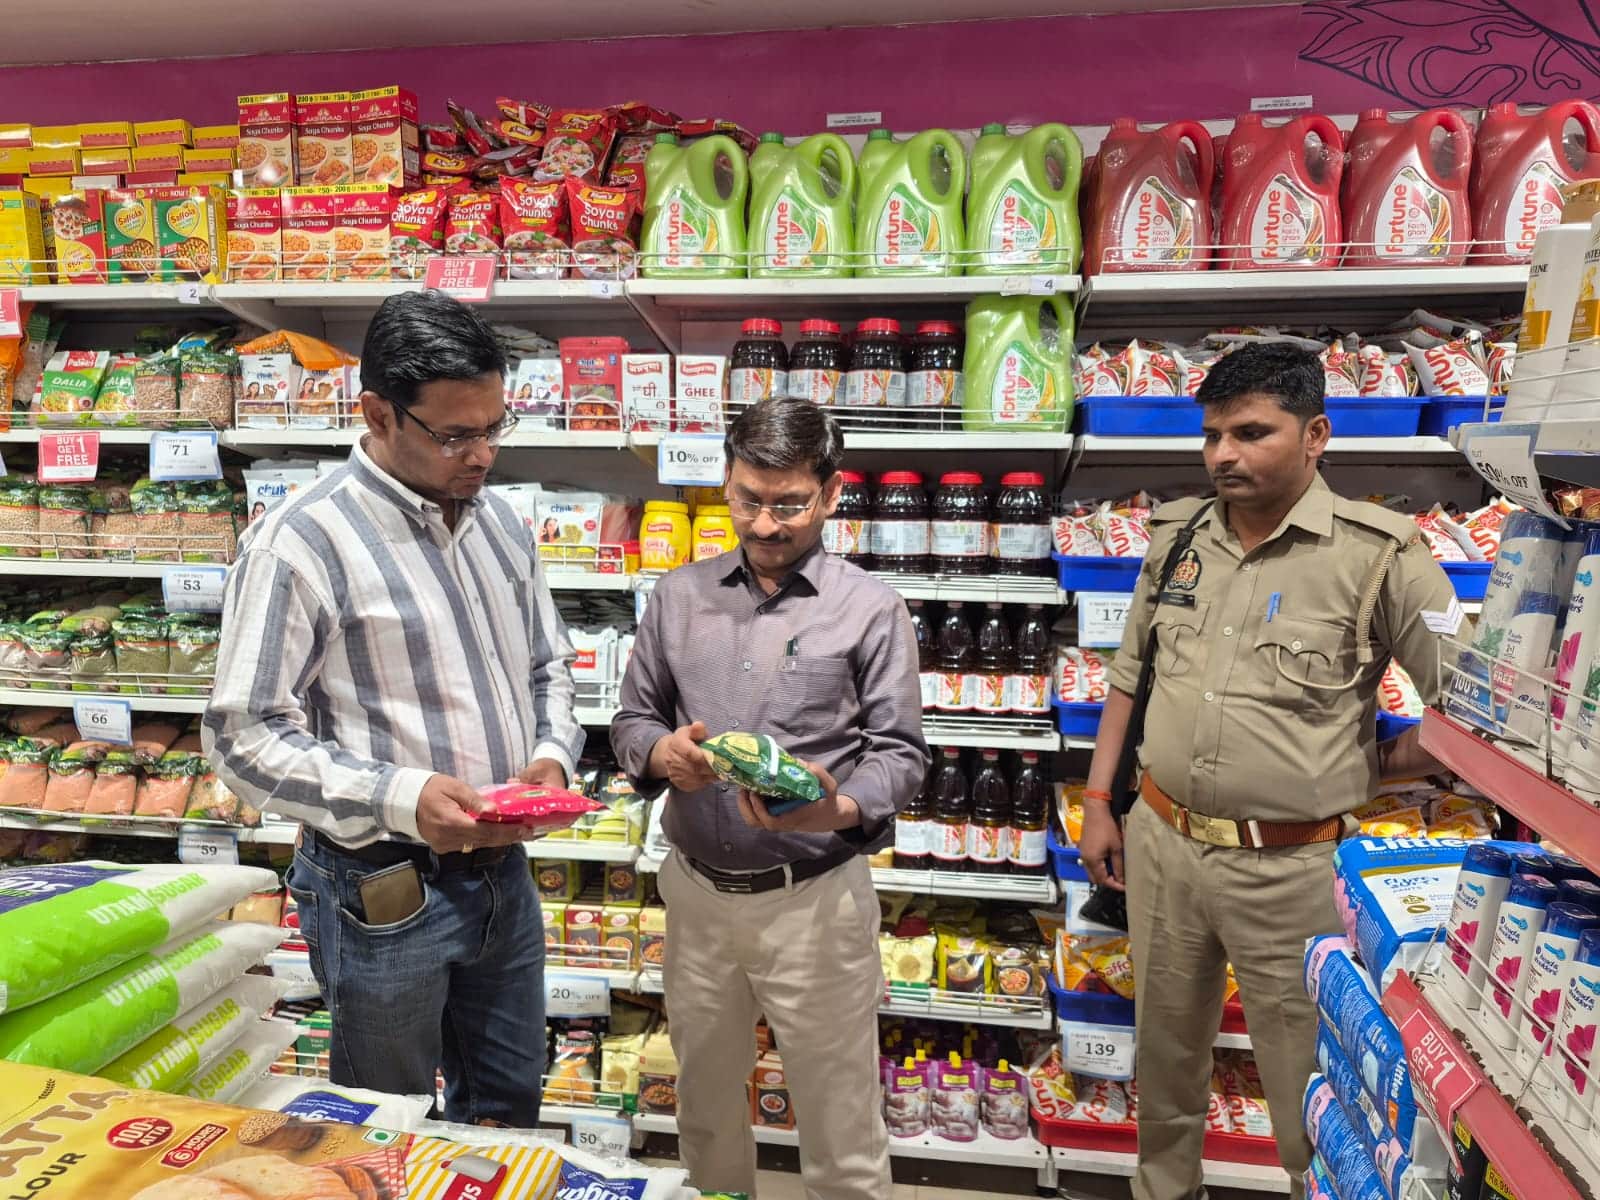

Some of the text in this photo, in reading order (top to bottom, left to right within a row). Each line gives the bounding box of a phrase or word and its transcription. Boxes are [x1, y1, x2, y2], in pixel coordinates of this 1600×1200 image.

[519, 194, 551, 208] Soya
[397, 204, 427, 215] Soya
[516, 206, 553, 219] Chunks
[584, 204, 615, 220] Soya
[1516, 179, 1539, 252] fortune
[391, 212, 427, 226] Chunks
[579, 215, 619, 231] Chunks
[1132, 191, 1153, 260] fortune
[1261, 190, 1281, 258] fortune
[1385, 183, 1408, 253] fortune
[666, 202, 680, 267] fortune
[772, 202, 790, 267] fortune
[883, 199, 901, 265] fortune
[444, 269, 465, 277] GET
[445, 260, 476, 276] BUY 1
[439, 277, 474, 288] FREE
[601, 283, 609, 294] 3
[1044, 280, 1054, 290] 4
[189, 288, 197, 298] 2
[52, 377, 88, 388] DALIA
[1000, 356, 1018, 419] fortune
[685, 387, 716, 397] GHEE
[57, 446, 76, 454] GET
[77, 437, 85, 453] 1
[171, 444, 190, 457] 71
[56, 454, 89, 465] FREE
[667, 450, 719, 464] 10% OFF
[1476, 462, 1529, 489] 50% OFF
[183, 579, 201, 591] 53
[91, 714, 108, 725] 66
[200, 845, 218, 856] 59
[86, 871, 208, 925] UTTAM SUGAR
[103, 932, 225, 1007] UTTAM SUGAR
[1096, 961, 1131, 978] Saffo
[551, 988, 581, 1000] 20%
[131, 997, 242, 1090] UTTAM SUGAR
[1085, 1042, 1115, 1056] 139
[1420, 1030, 1446, 1061] BUY
[1411, 1047, 1434, 1076] GET
[199, 1048, 252, 1099] SUGAR
[1431, 1060, 1456, 1090] 1
[140, 1124, 172, 1146] ATTA
[187, 1124, 217, 1149] HOURS
[9, 1152, 87, 1200] LOUR
